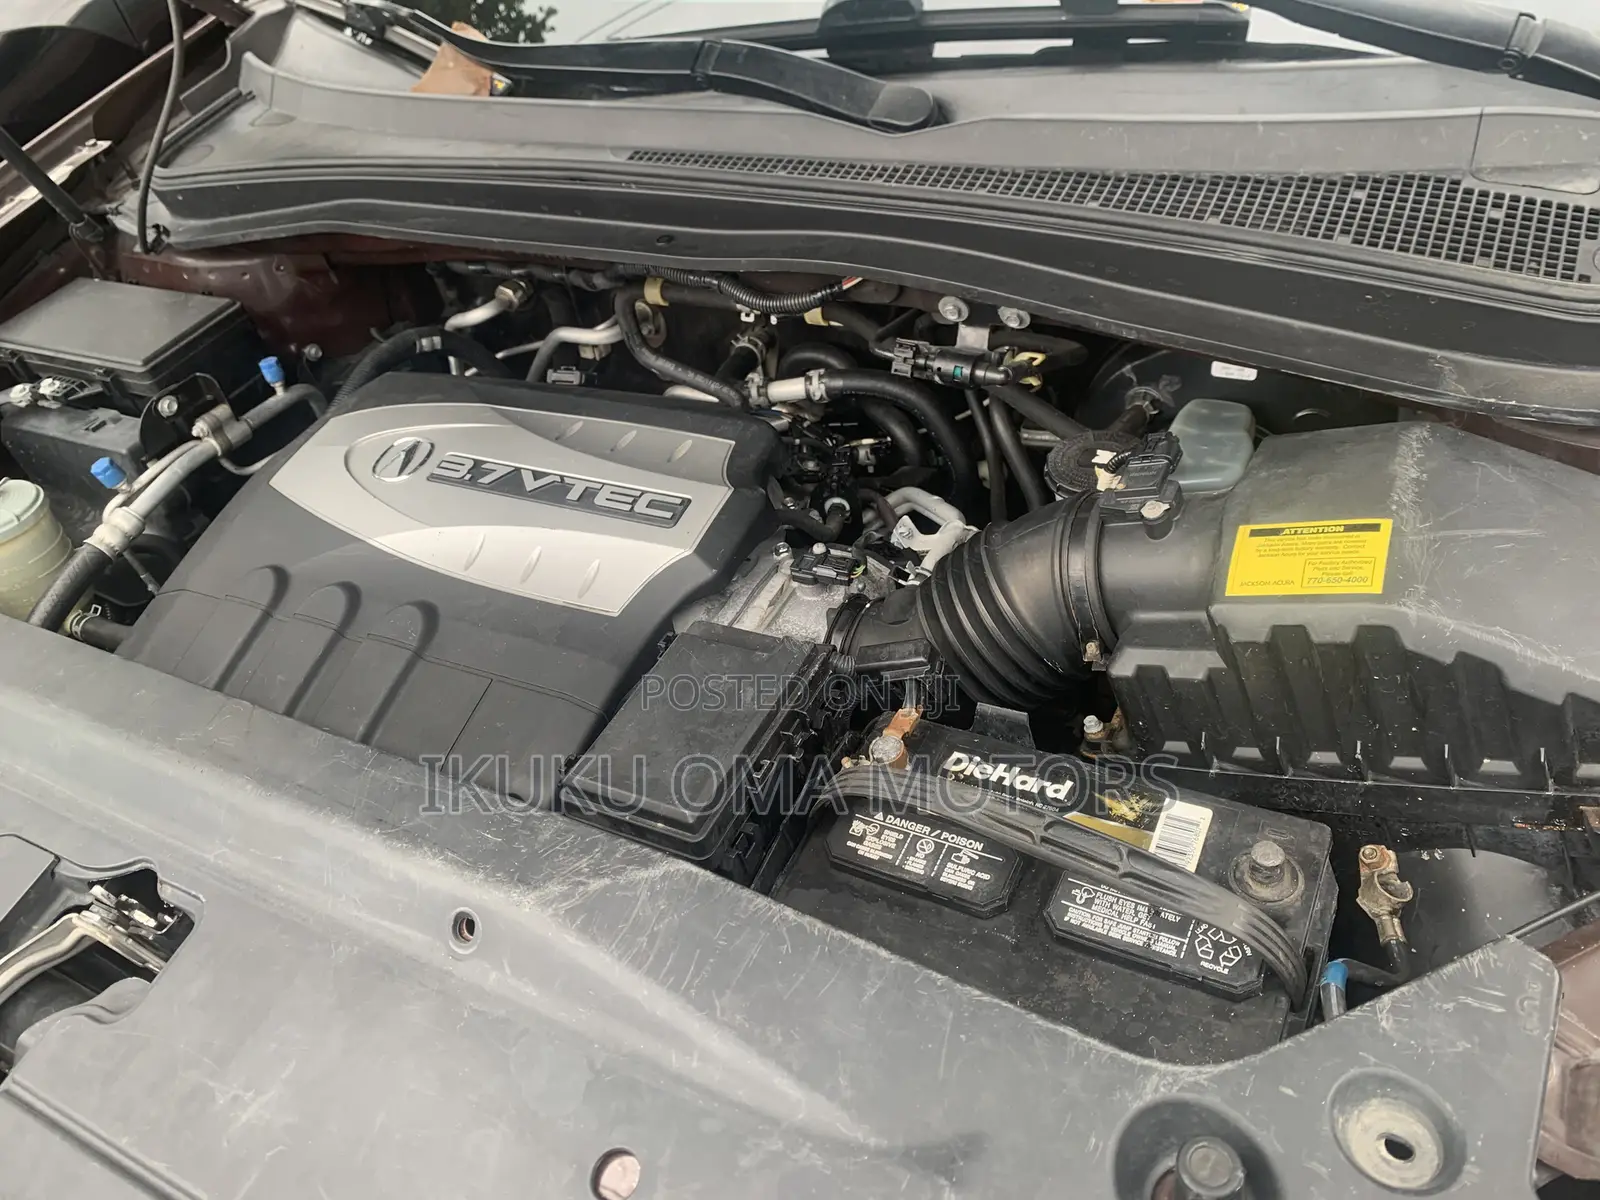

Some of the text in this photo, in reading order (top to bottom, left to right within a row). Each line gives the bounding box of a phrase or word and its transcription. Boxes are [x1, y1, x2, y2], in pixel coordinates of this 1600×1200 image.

[431, 457, 684, 520] 3.7 VTEC
[1280, 525, 1345, 536] ATTENTION
[1306, 576, 1369, 585] 770-650-4000
[942, 750, 1075, 802] DieHard
[885, 815, 931, 835] DANGER
[940, 831, 984, 851] POISON
[946, 862, 991, 881] SULFURIC ACID
[1094, 897, 1111, 909] WITH
[1095, 891, 1118, 904] FLUSH
[1118, 898, 1136, 910] EYES
[1091, 903, 1119, 919] MEDICAL
[1120, 912, 1139, 924] HELP
[1200, 960, 1230, 975] RECYCLE
